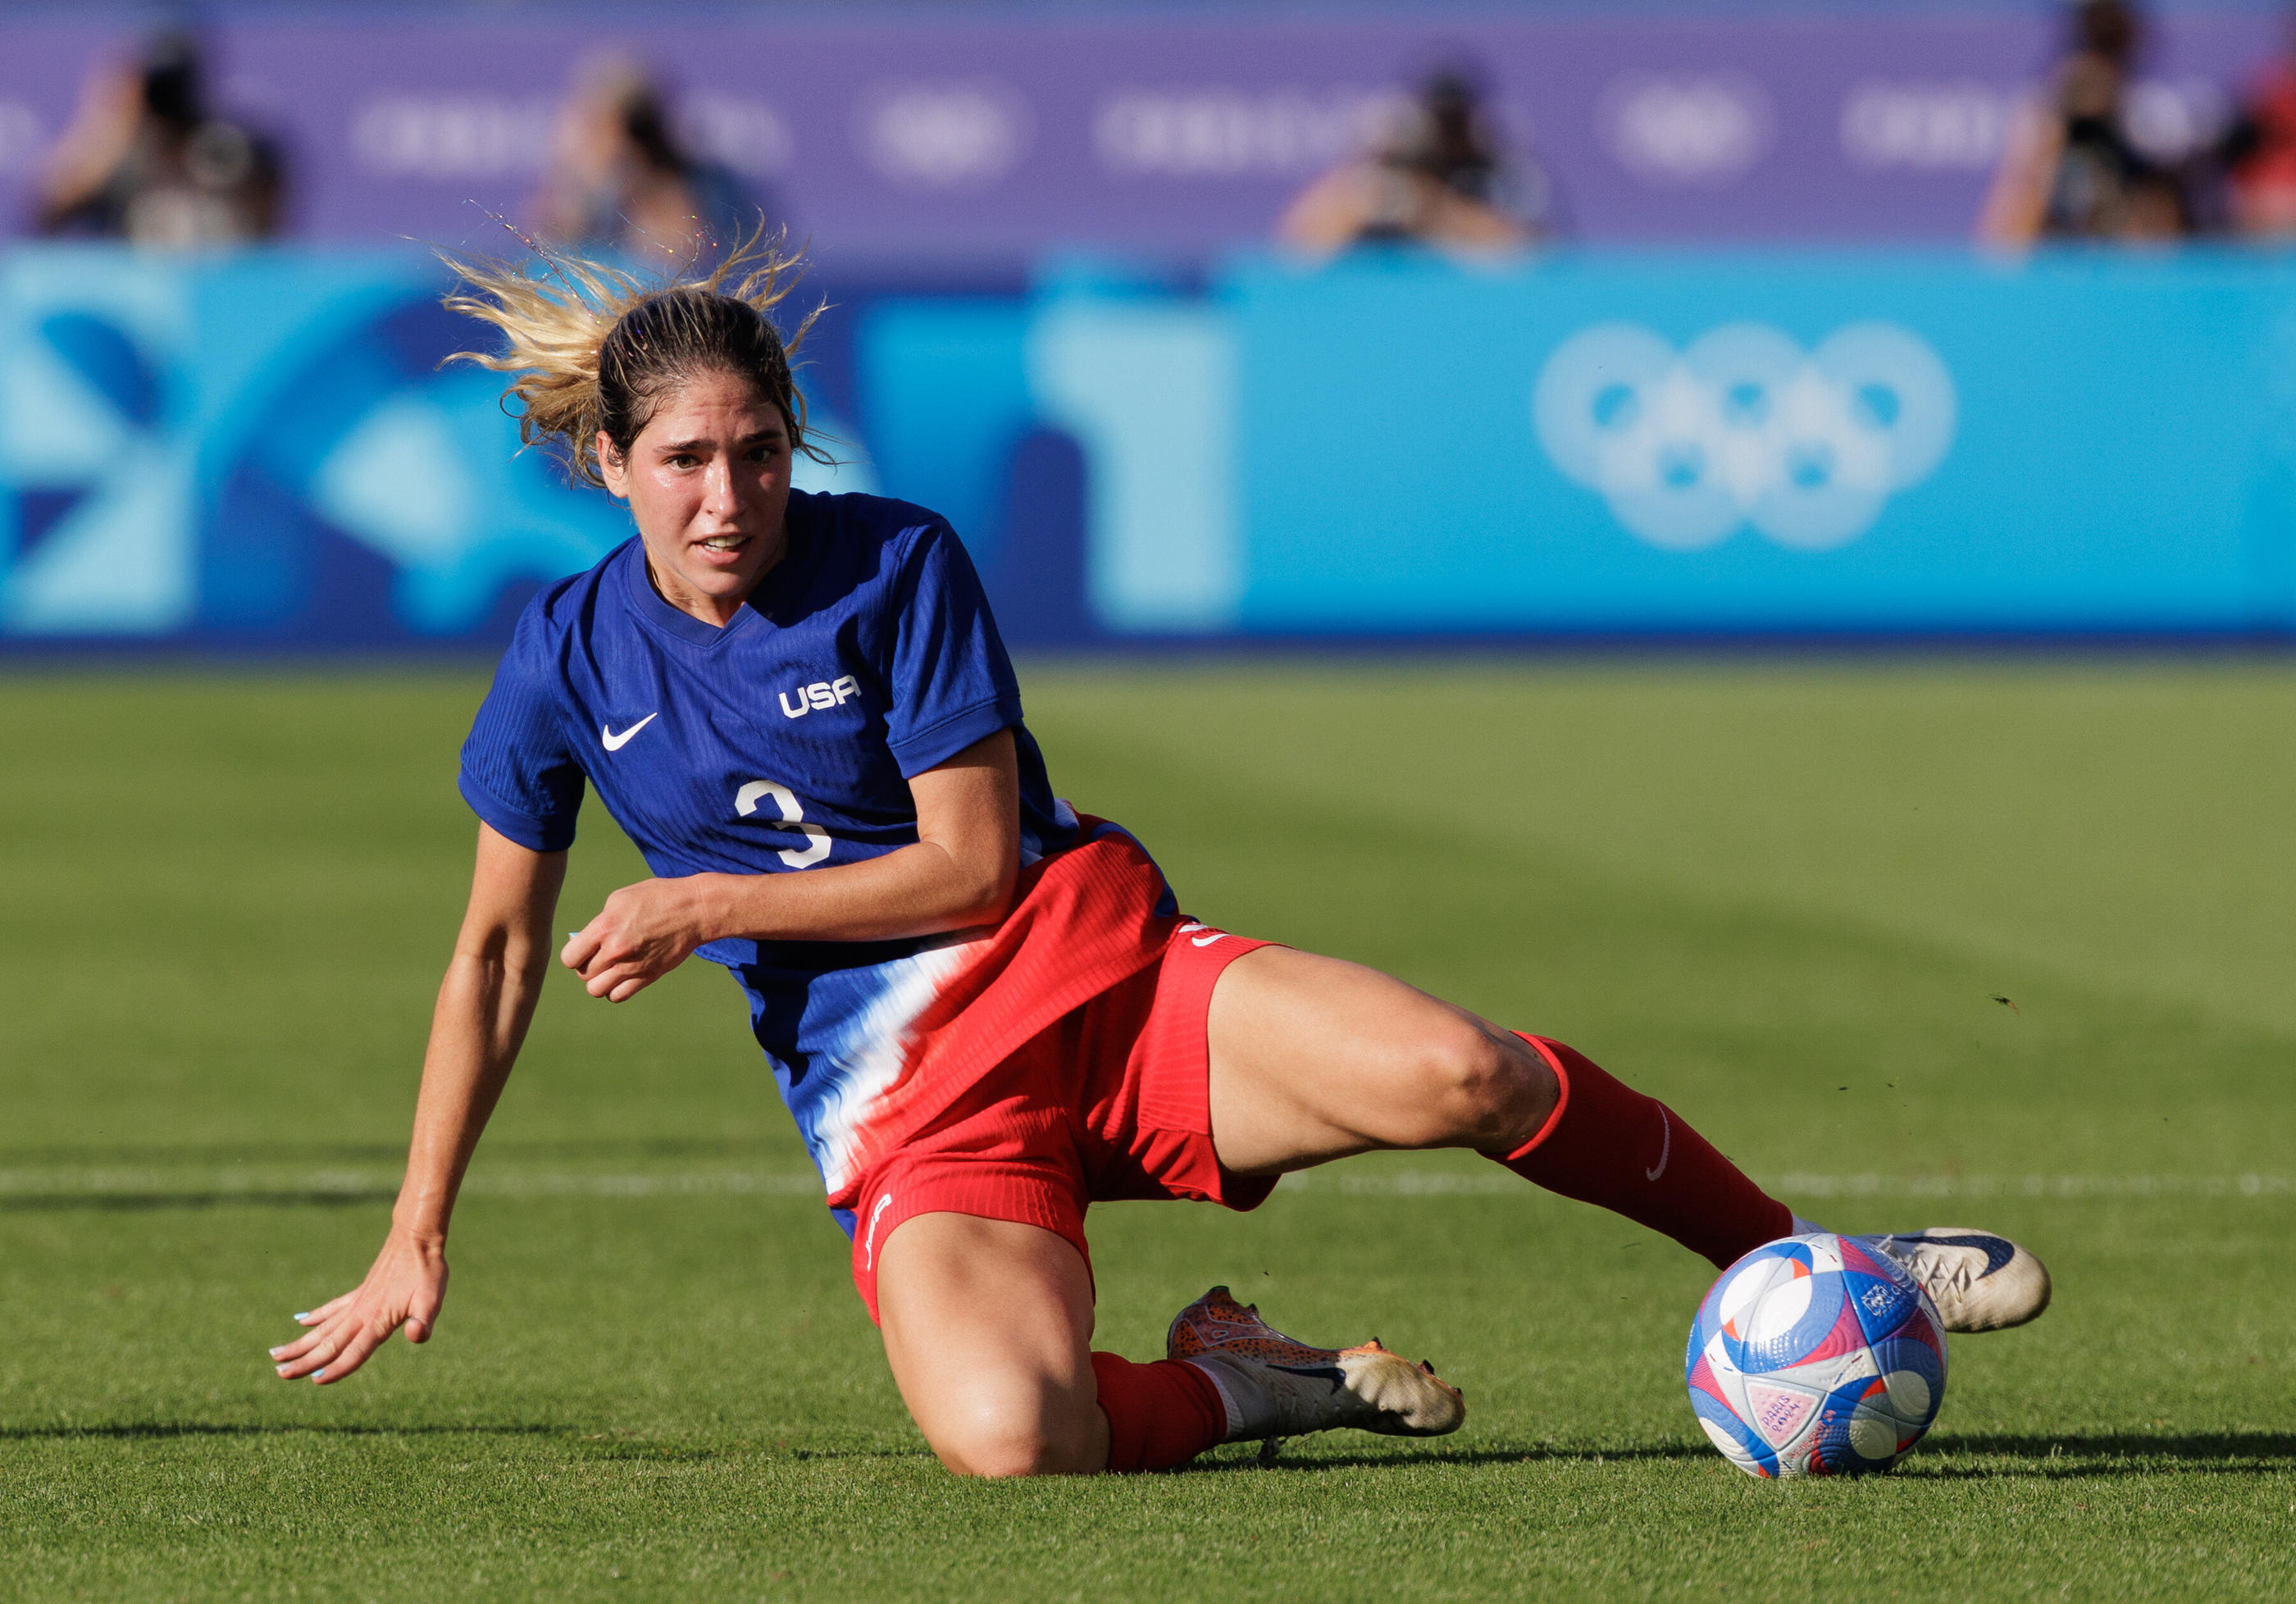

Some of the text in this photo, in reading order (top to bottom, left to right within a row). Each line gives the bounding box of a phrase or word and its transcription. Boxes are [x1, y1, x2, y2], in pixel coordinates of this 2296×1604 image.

[778, 674, 862, 718] USA
[735, 780, 832, 869] 3
[1762, 1396, 1790, 1426] PARIS
[1772, 1404, 1799, 1433] 2024
